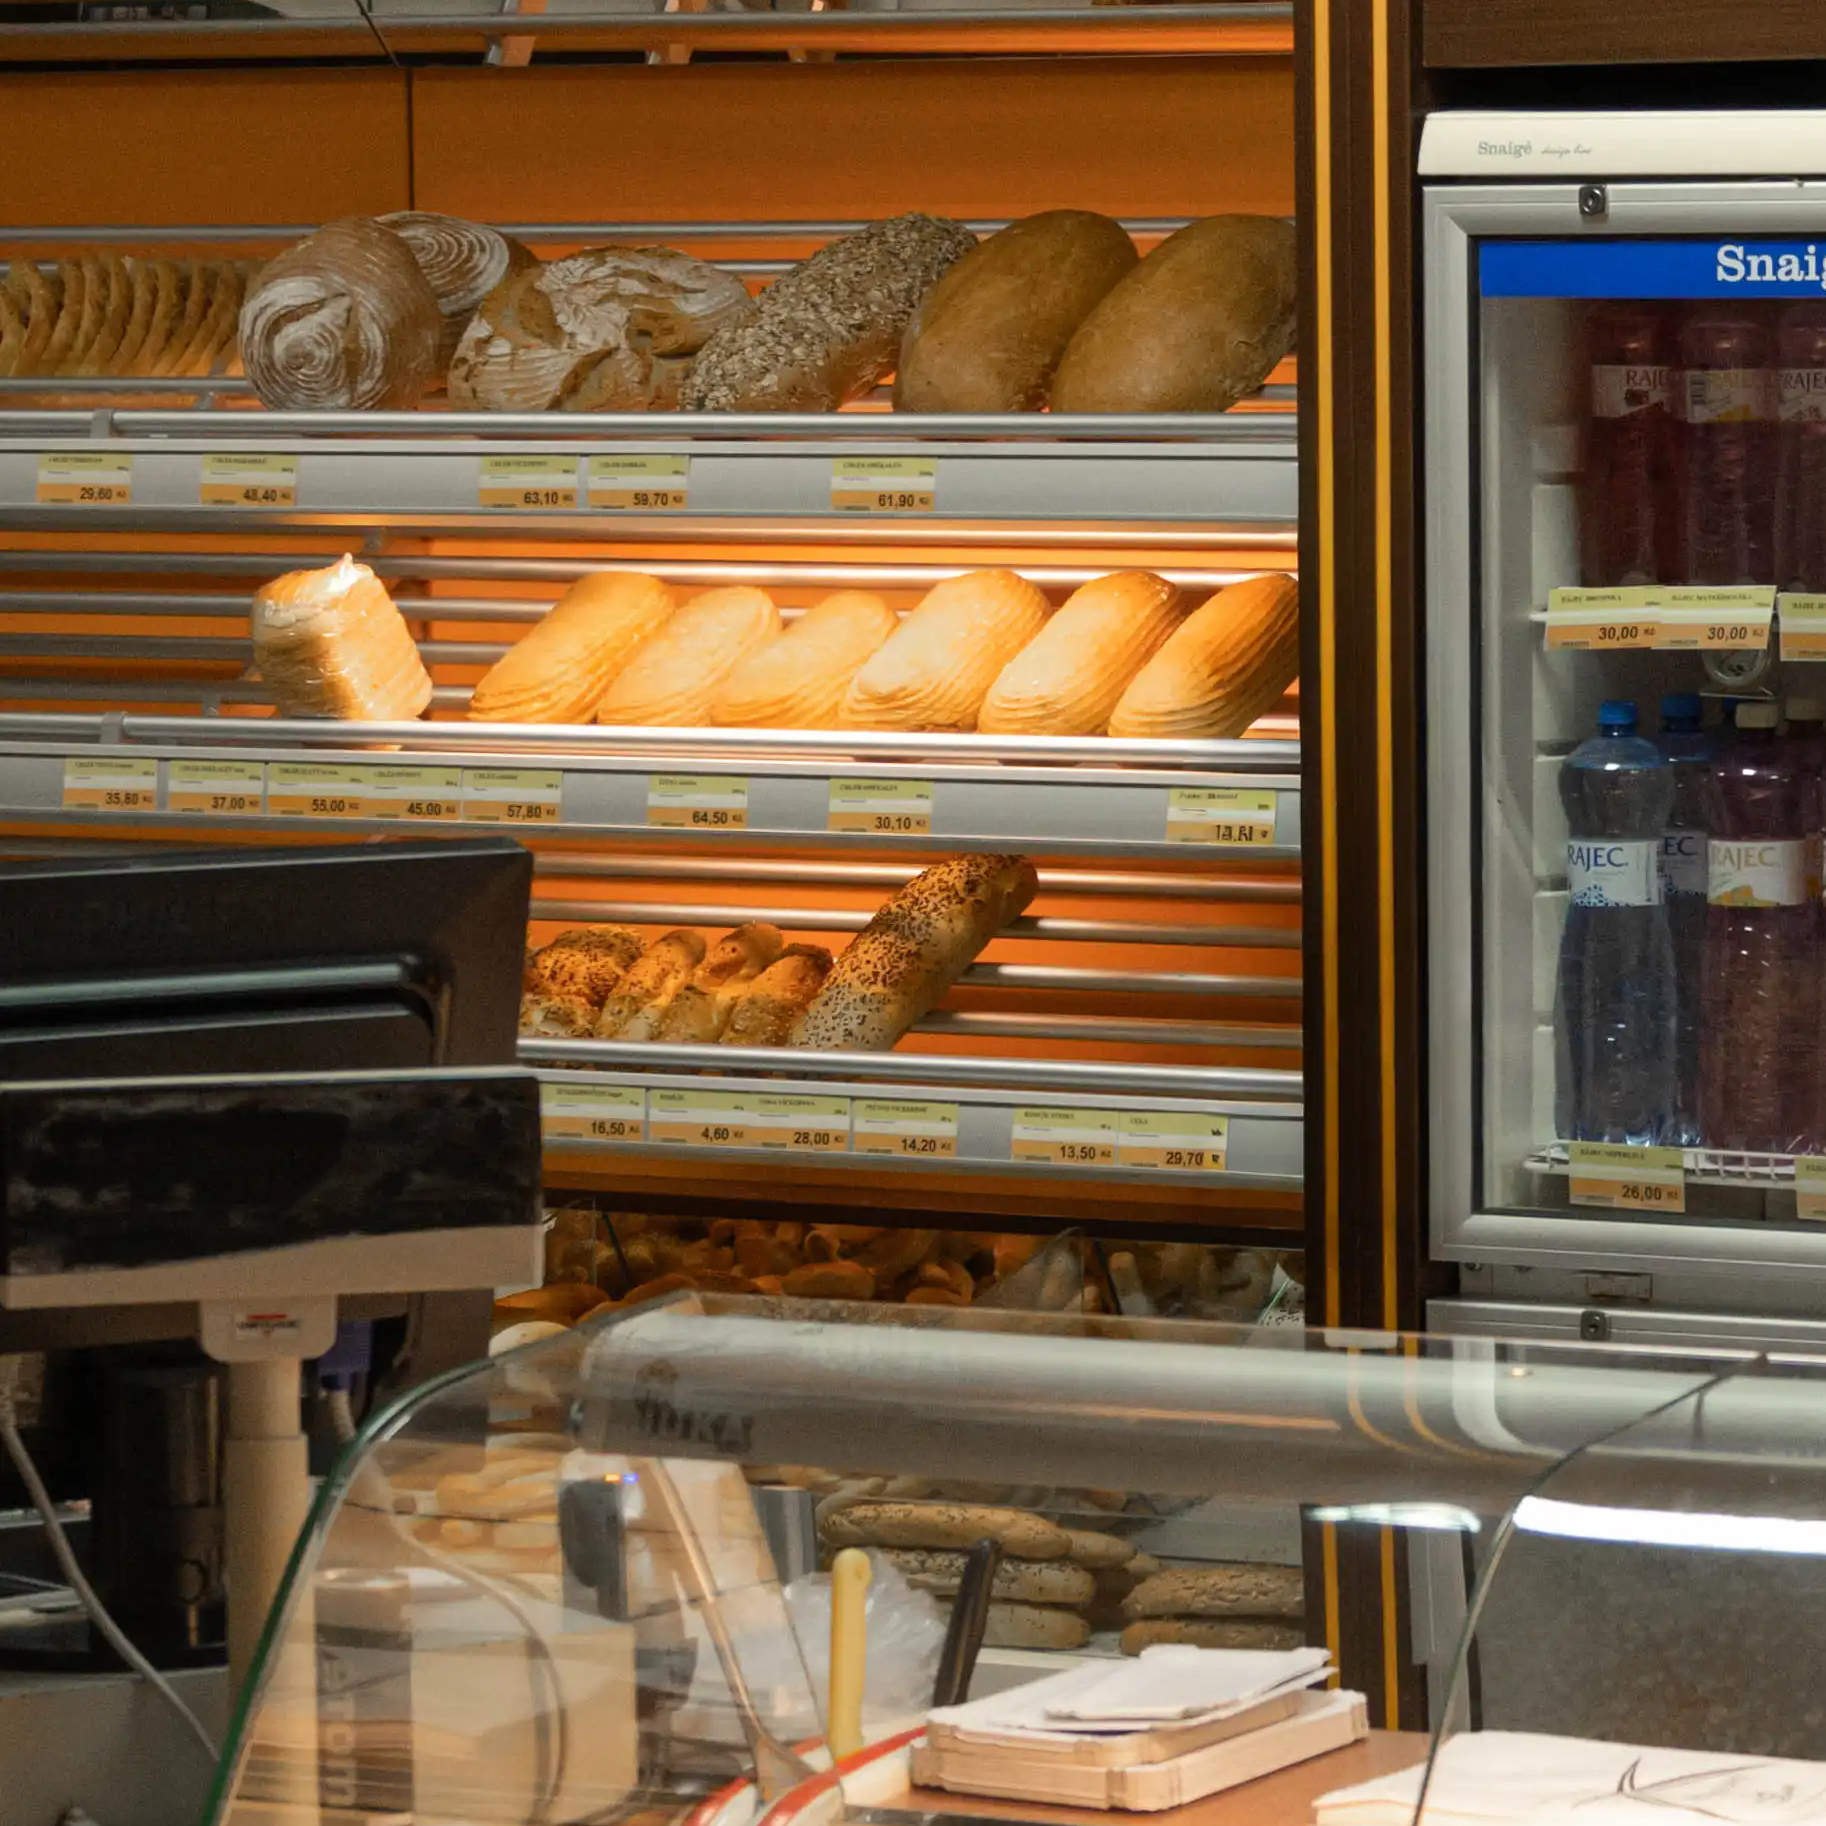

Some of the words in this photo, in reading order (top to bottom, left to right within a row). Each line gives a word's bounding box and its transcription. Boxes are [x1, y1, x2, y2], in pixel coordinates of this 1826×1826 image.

[1478, 140, 1532, 159] Snaigė
[1625, 368, 1671, 390] RAJE
[524, 492, 558, 505] 63,10
[632, 493, 668, 506] 59,70
[878, 494, 915, 509] 61,90
[1598, 626, 1638, 642] 30,00
[1707, 627, 1748, 642] 30,00
[211, 796, 245, 811] 37,00
[507, 805, 541, 820] 57,80
[692, 811, 728, 825] 64,50
[874, 816, 911, 831] 30,10
[1568, 845, 1625, 872] RAJEC
[1711, 845, 1776, 870] RAJEC
[591, 1121, 625, 1136] 16,50
[794, 1132, 829, 1146] 28,00
[901, 1138, 936, 1152] 14,20
[1060, 1145, 1096, 1160] 13,50
[1166, 1151, 1204, 1167] 29,70
[1622, 1184, 1662, 1201] 26,00
